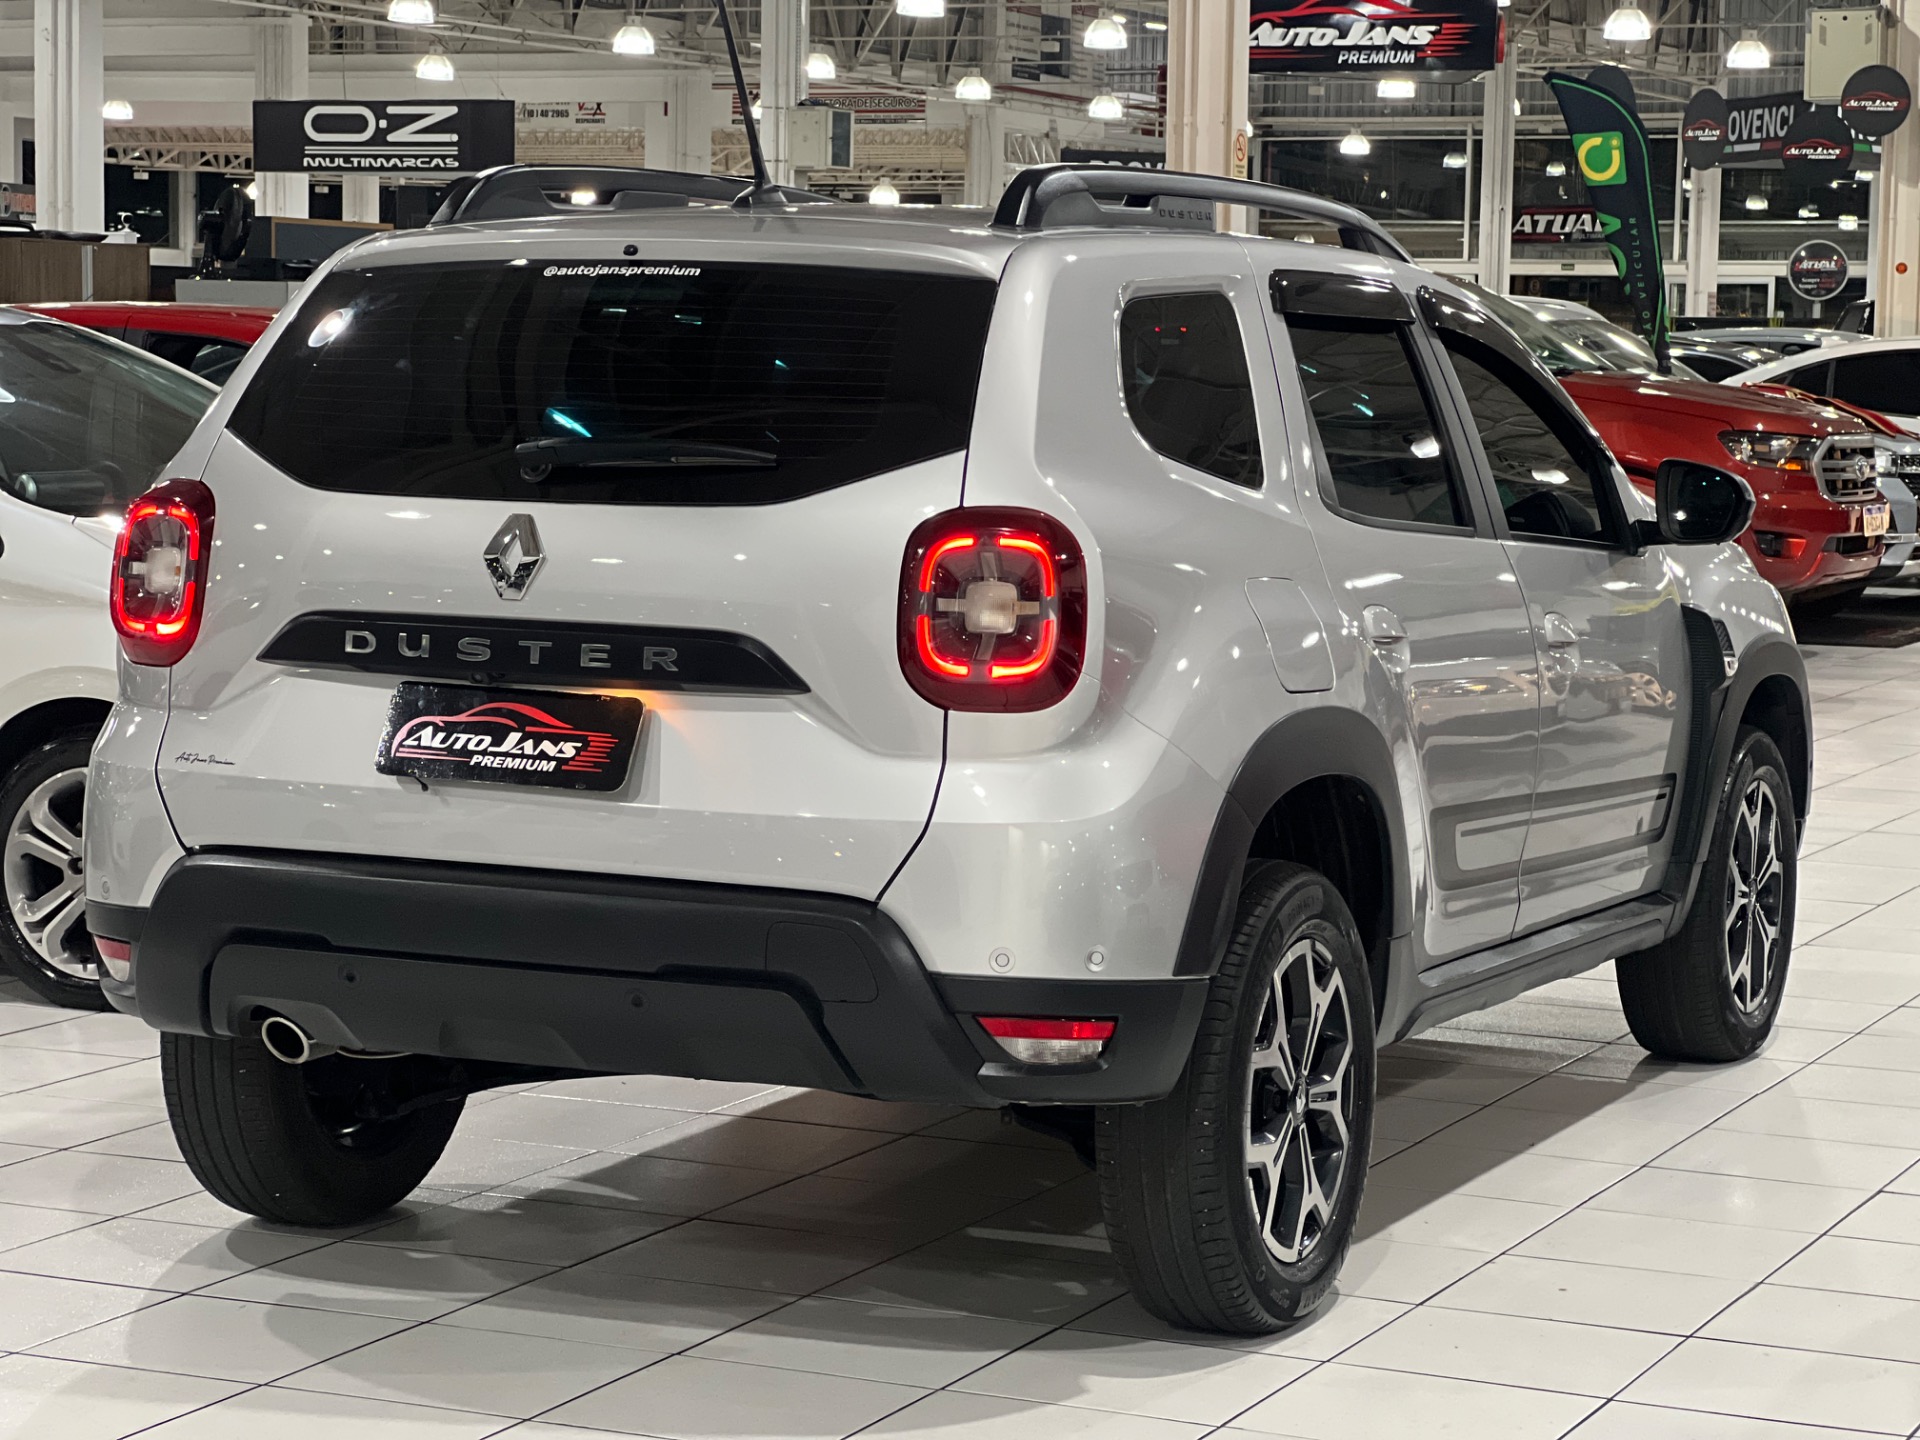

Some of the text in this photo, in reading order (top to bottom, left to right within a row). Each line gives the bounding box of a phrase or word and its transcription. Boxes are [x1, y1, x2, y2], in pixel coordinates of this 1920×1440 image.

[1337, 50, 1416, 64] PREMIUM
[873, 97, 918, 108] SEGUROS
[303, 157, 459, 168] MULTIMARCAS
[1159, 208, 1212, 221] DUSTER
[1628, 216, 1647, 299] VEICULAR
[543, 264, 701, 277] @autojanspremium
[344, 629, 679, 672] DUSTER
[469, 755, 557, 772] PREMIUM
